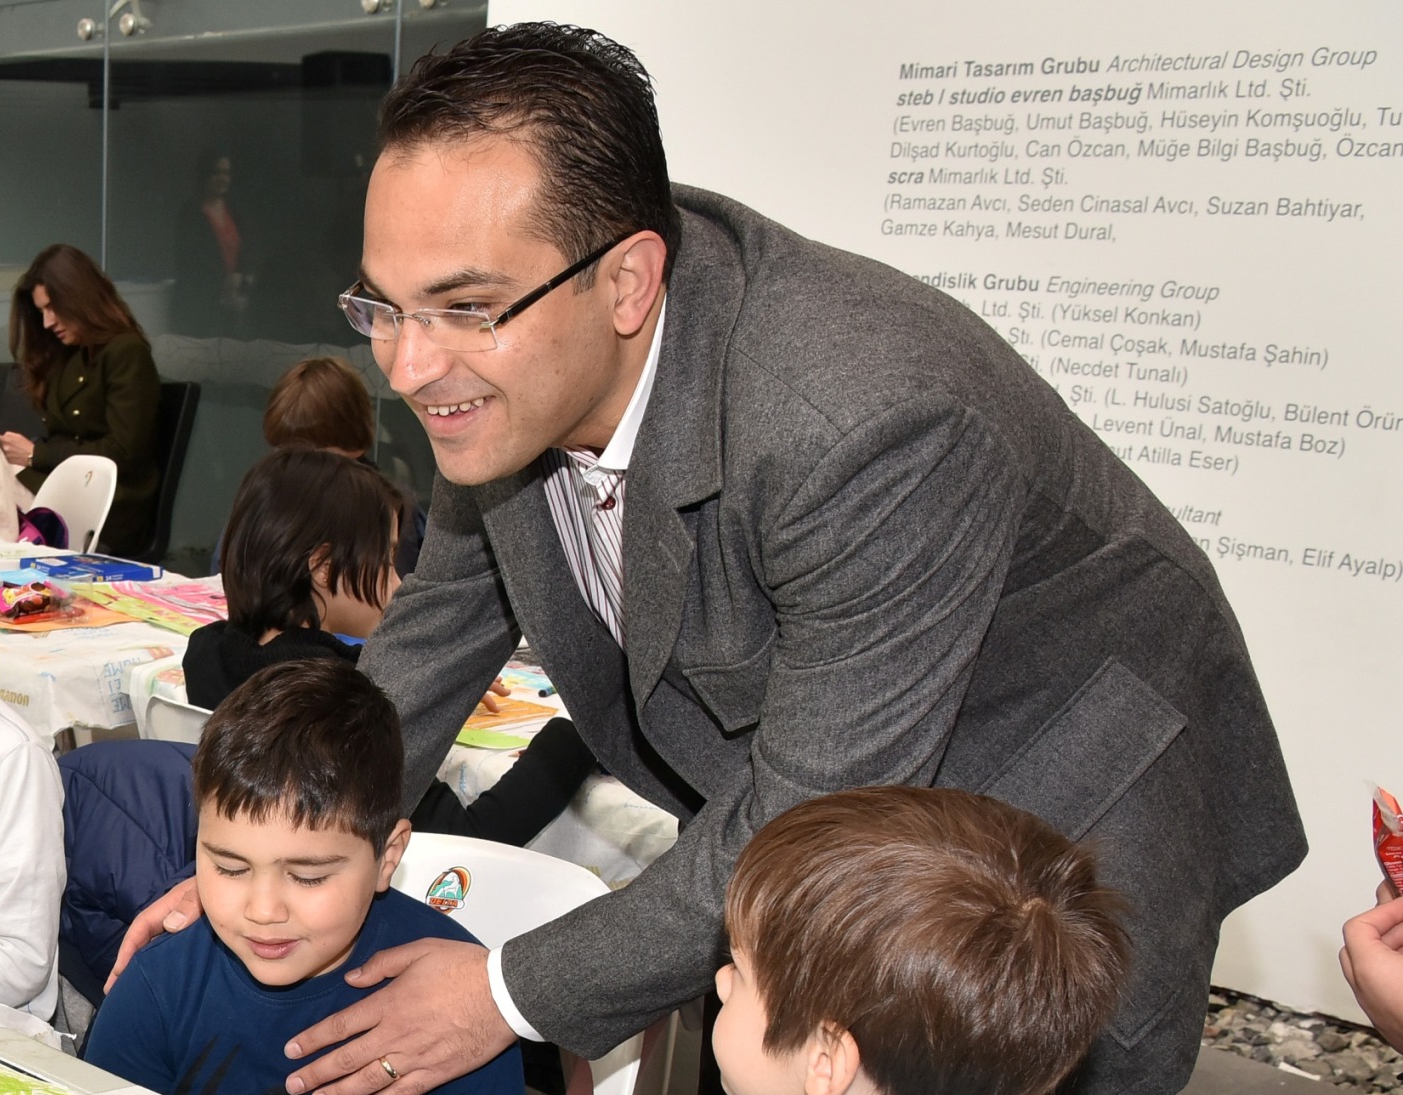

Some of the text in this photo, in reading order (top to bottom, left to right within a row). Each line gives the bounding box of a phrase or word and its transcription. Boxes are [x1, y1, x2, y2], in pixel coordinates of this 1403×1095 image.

[898, 60, 959, 81] Mimari
[1040, 56, 1101, 76] Grubu
[1105, 50, 1229, 73] Architectural
[1232, 48, 1305, 73] Design
[1310, 46, 1378, 71] Group
[895, 88, 935, 107] steb
[948, 86, 1006, 106] studio
[1009, 88, 1064, 104] evren
[1234, 79, 1271, 99] Ltd.
[1026, 113, 1074, 131] Umut
[1025, 139, 1062, 158] Can
[1196, 138, 1239, 163] Bilgi
[886, 171, 925, 185] scra
[1003, 167, 1034, 185] Ltd.
[1017, 193, 1075, 213] Seden
[1080, 194, 1149, 214] Cinasal
[1206, 195, 1269, 216] Suzan
[880, 218, 938, 237] Gamze
[1005, 221, 1059, 240] Mesut
[982, 272, 1040, 293] Grubu
[1045, 275, 1155, 303] Engineering
[1160, 279, 1221, 305] Group
[981, 300, 1010, 319] Ltd.
[1179, 338, 1257, 362] Mustafa
[1133, 390, 1192, 412] Hulusi
[1092, 413, 1154, 437] Levent
[1214, 424, 1293, 450] Mustafa
[1136, 445, 1182, 466] Atilla
[1301, 547, 1335, 568] Elif
